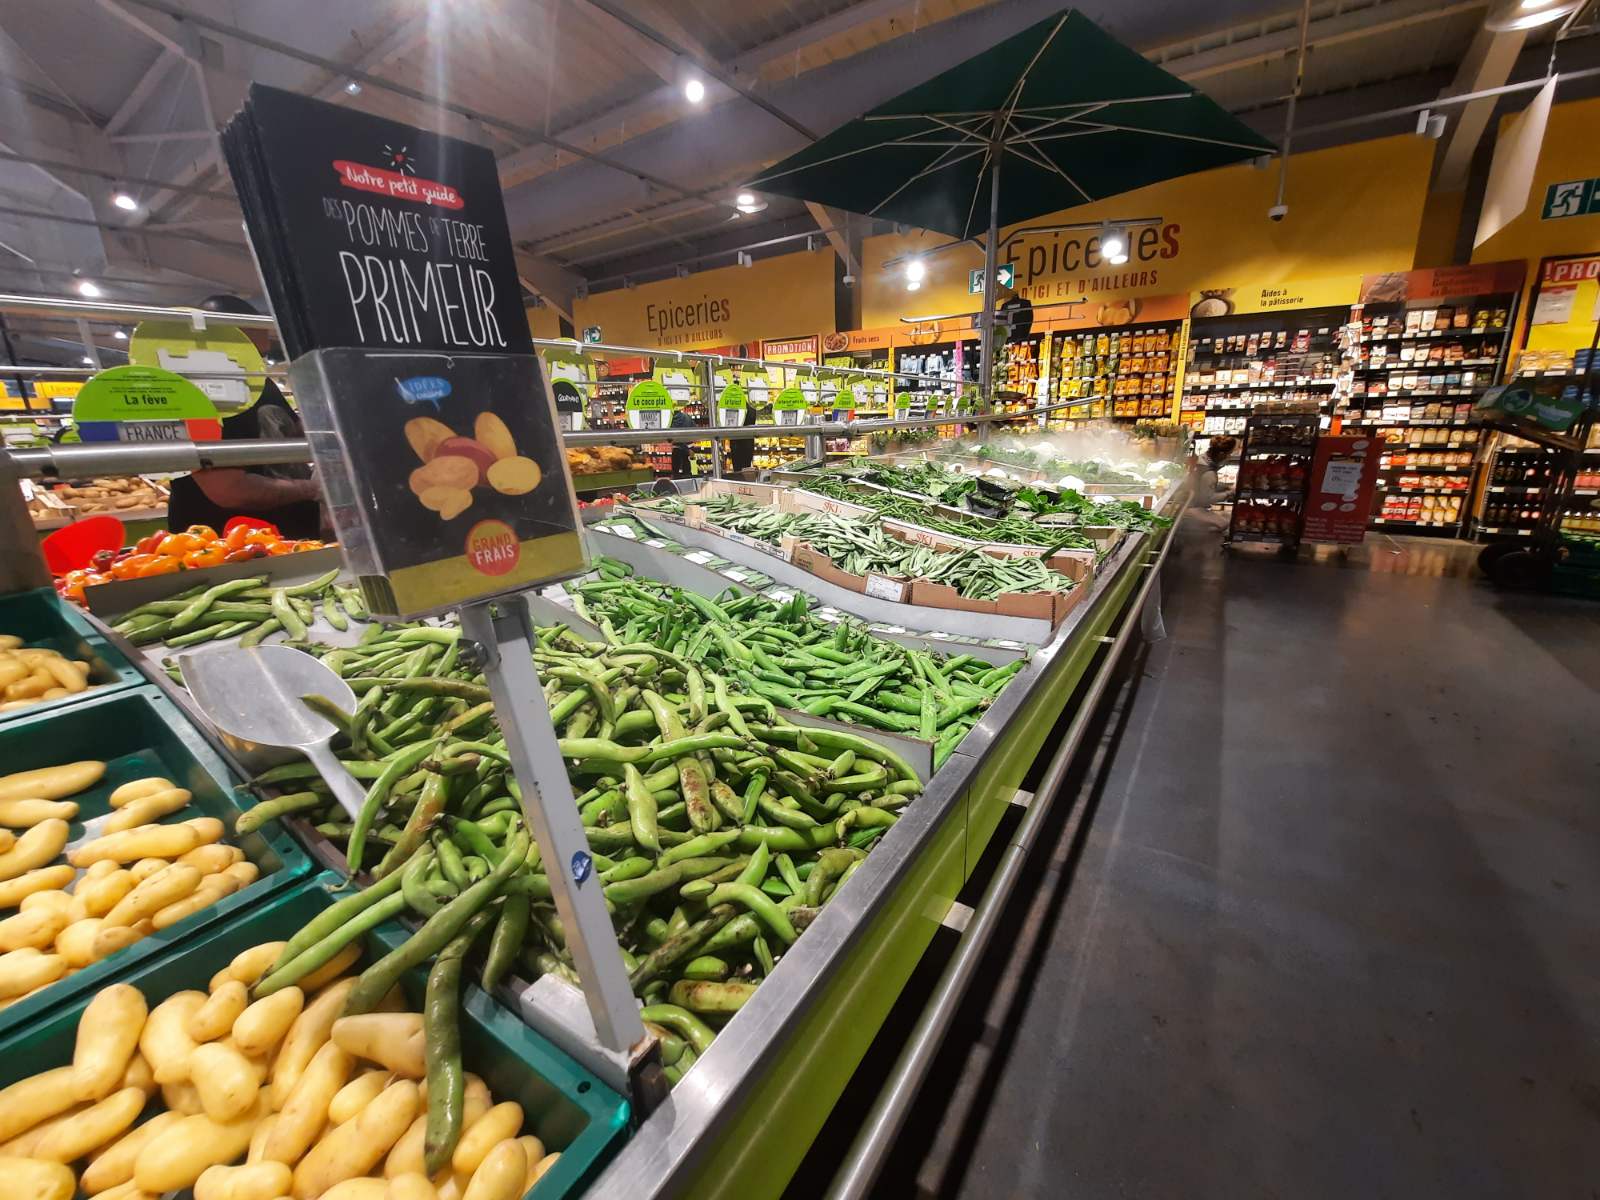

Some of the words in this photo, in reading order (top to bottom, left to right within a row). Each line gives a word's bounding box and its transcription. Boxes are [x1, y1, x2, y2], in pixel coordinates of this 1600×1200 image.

[346, 166, 386, 188] Notre
[389, 178, 418, 196] petit
[422, 187, 457, 205] guide
[323, 197, 342, 218] DES
[342, 200, 429, 253] POMMES
[441, 218, 489, 262] TERRE
[1056, 281, 1071, 297] ET
[1078, 270, 1158, 294] D'AILLEURS
[1261, 289, 1281, 298] Aides
[339, 251, 507, 347] PRIMEUR
[646, 295, 730, 336] Epiceries
[852, 336, 867, 344] Fruits
[124, 394, 138, 405] La
[142, 394, 168, 405] fève
[125, 425, 179, 440] FRANCE
[475, 544, 514, 564] FRAIS
